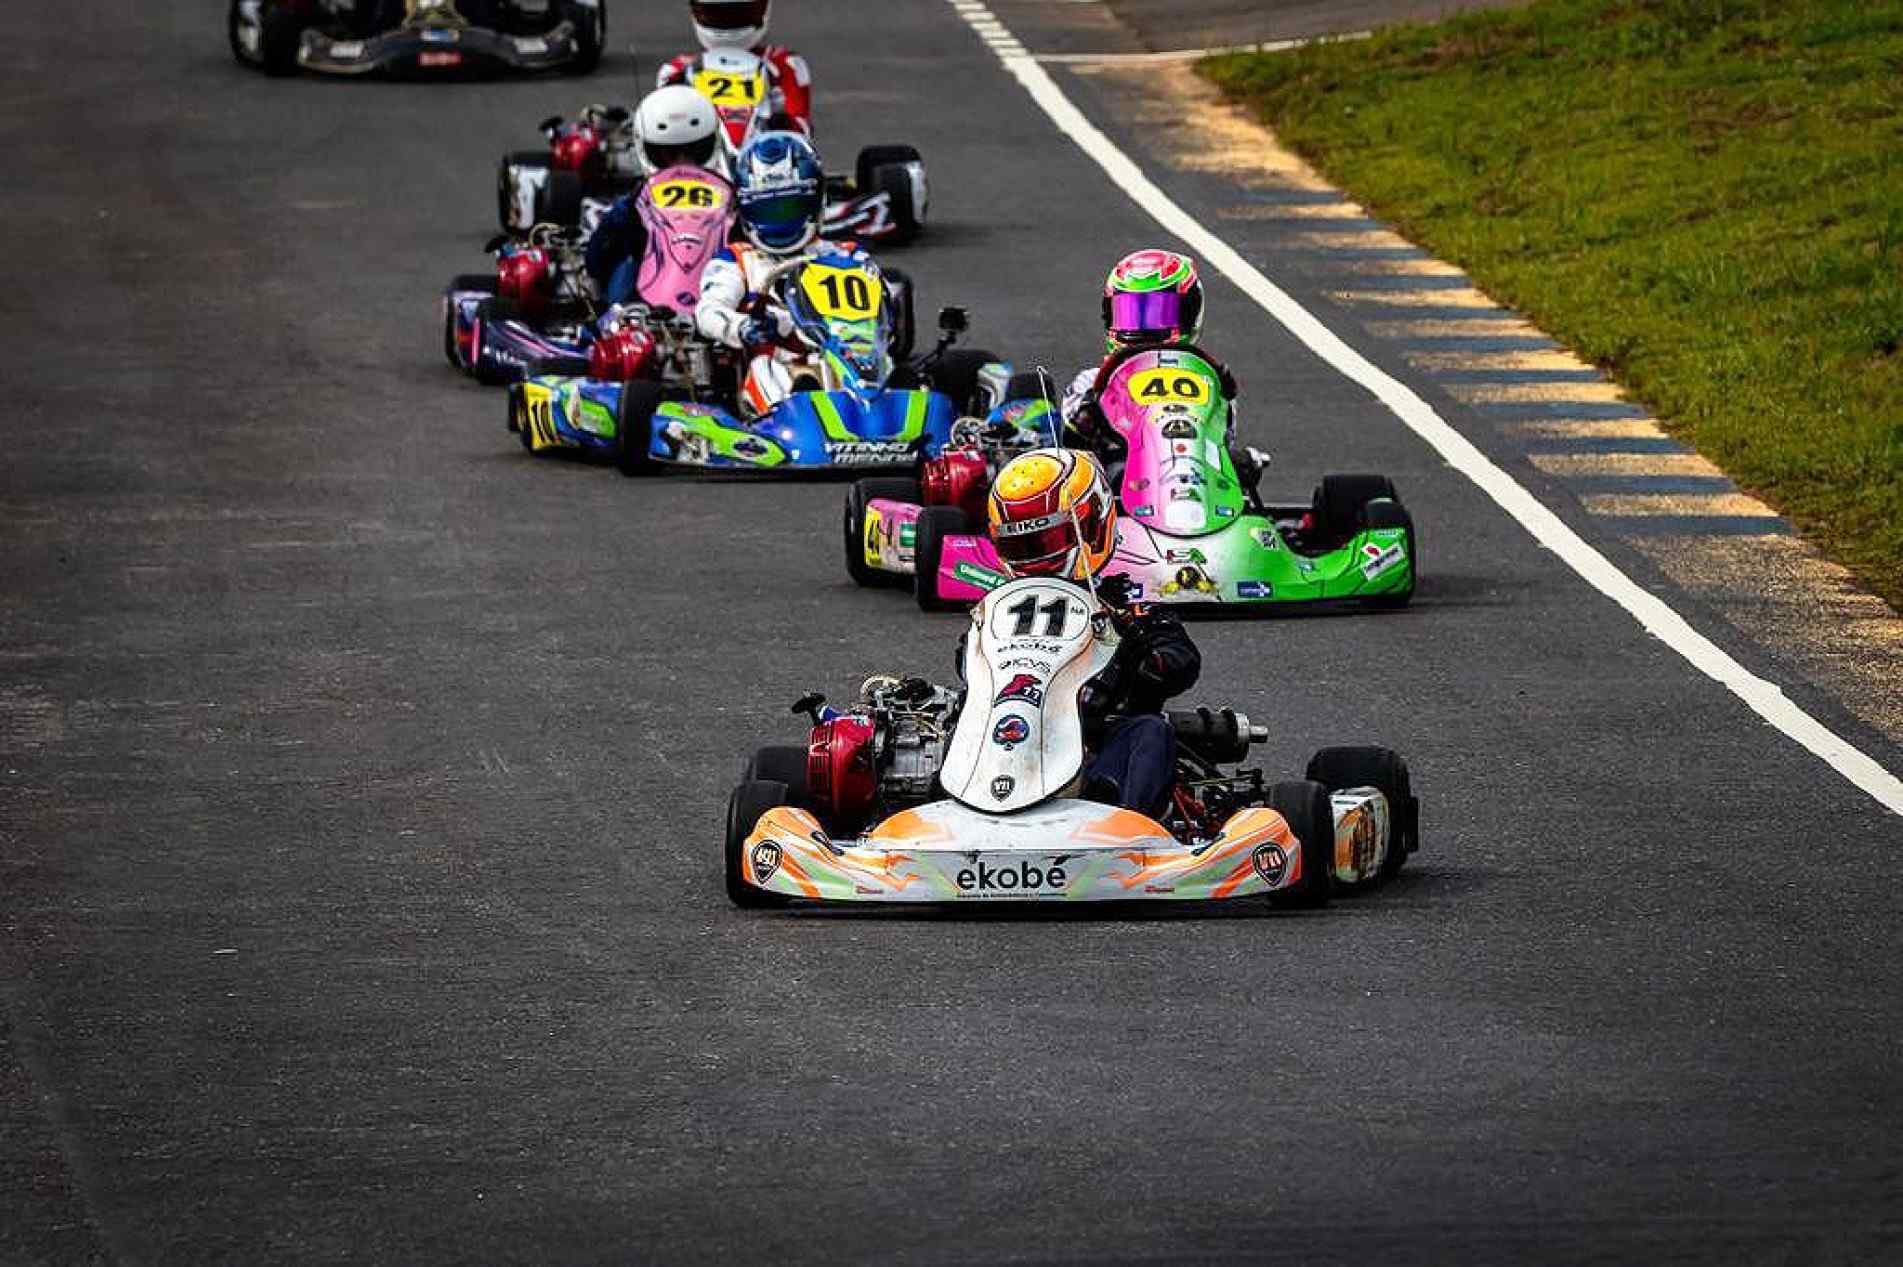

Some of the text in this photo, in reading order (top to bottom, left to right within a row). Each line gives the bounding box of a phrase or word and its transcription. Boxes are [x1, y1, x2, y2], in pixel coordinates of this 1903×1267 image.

[707, 78, 755, 99] 21
[662, 186, 713, 207] 26
[819, 274, 870, 311] 10
[1140, 378, 1200, 398] 40
[1008, 595, 1069, 636] 11
[957, 854, 1070, 889] ekobé
